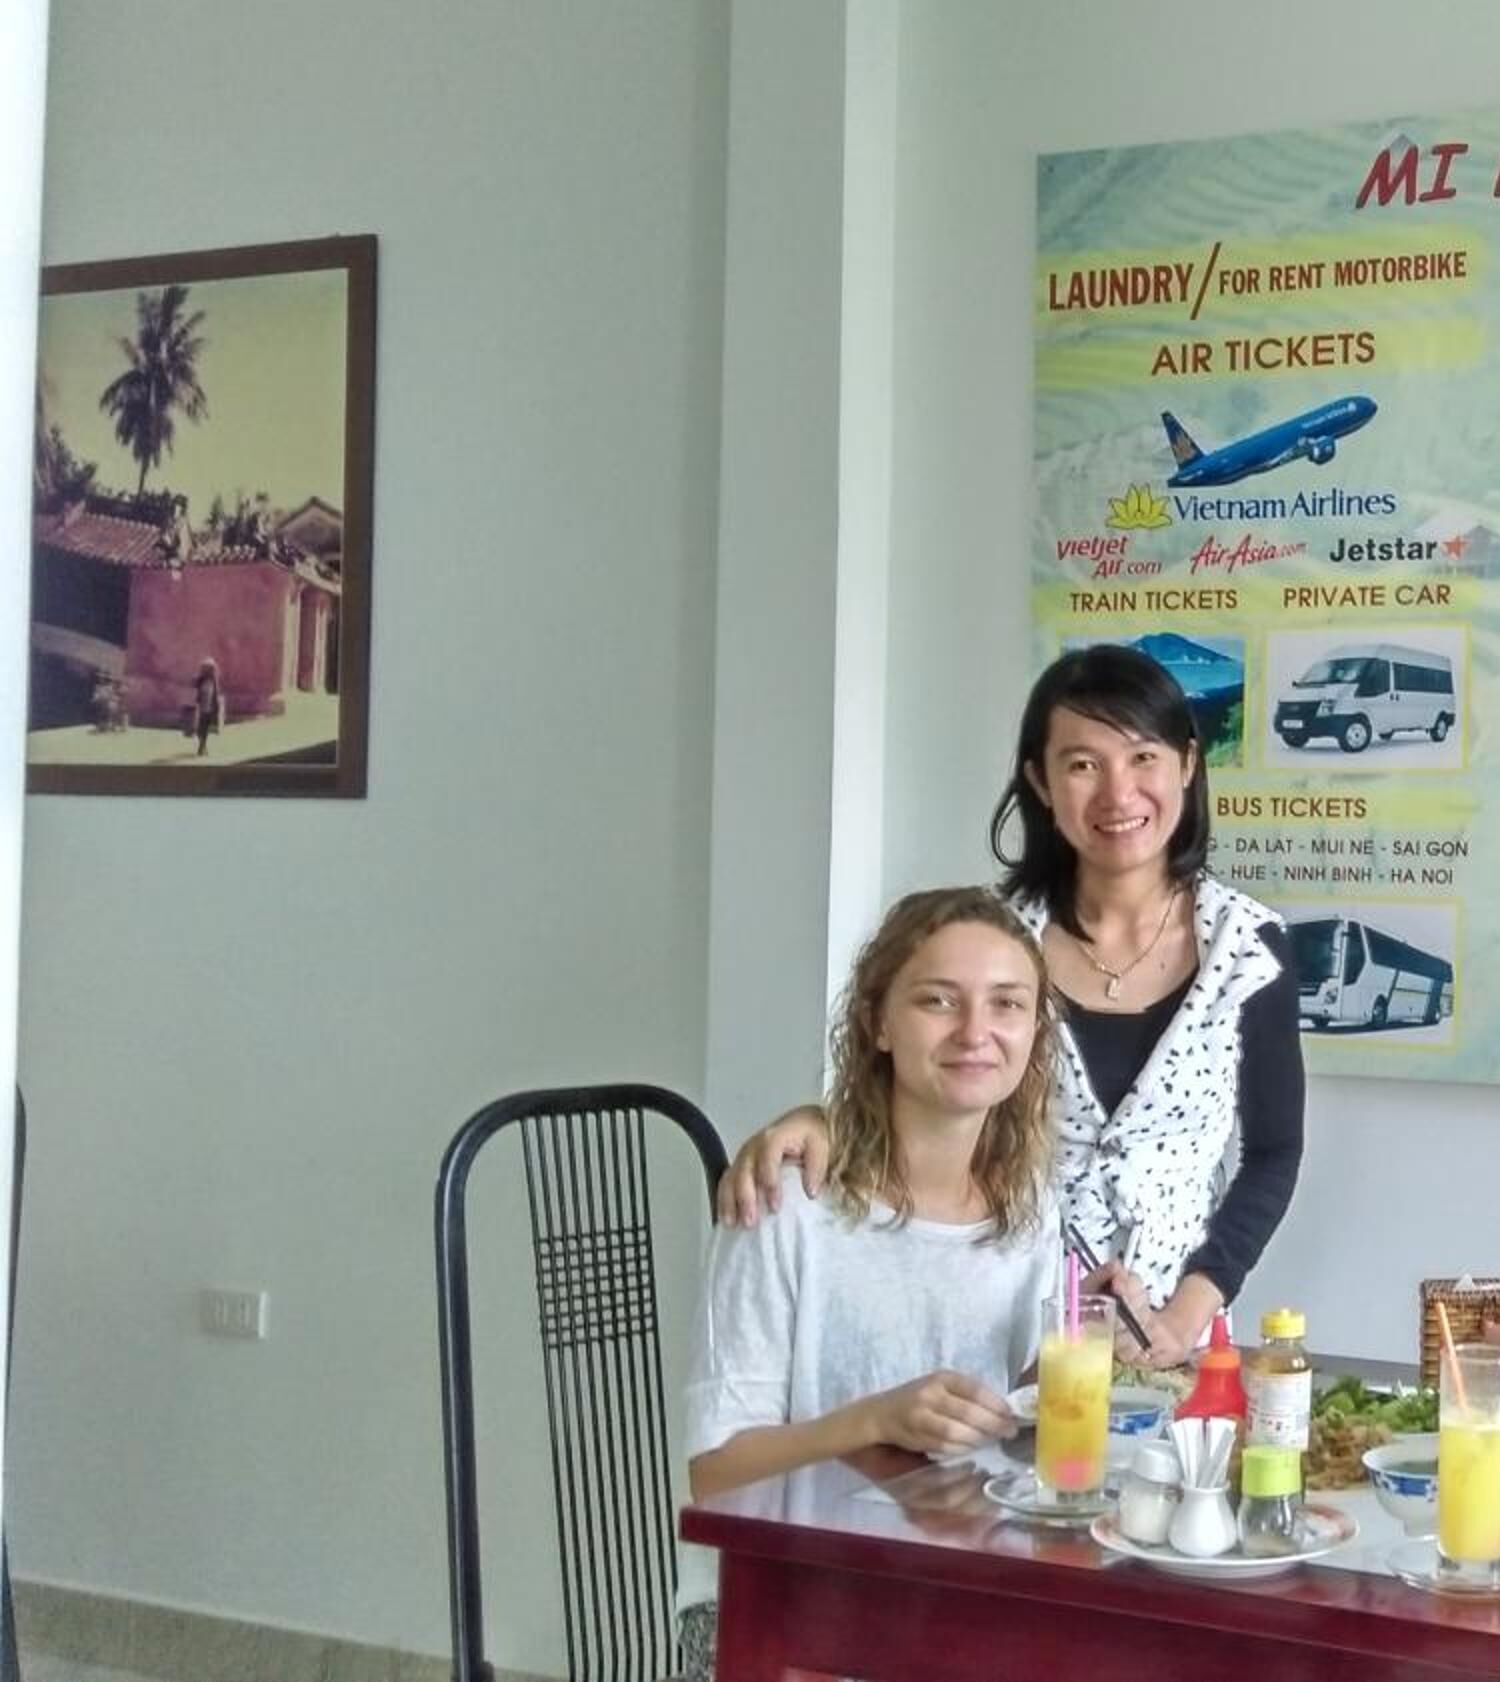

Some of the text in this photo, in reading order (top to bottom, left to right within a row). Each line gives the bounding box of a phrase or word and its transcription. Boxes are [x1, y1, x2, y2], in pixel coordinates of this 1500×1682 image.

[1356, 143, 1468, 209] MI
[1219, 269, 1260, 295] FOR
[1269, 263, 1325, 292] RENT
[1334, 251, 1467, 287] MOTORBIKE
[1151, 332, 1376, 376] AIR TICKETS
[1171, 488, 1397, 522] Vietnam Airlines
[1329, 537, 1438, 562] Jetstar
[1070, 589, 1238, 613] TRAIN TICKETS
[1283, 583, 1451, 608] PRIVATE CAR
[1217, 797, 1367, 819] BUS TICKETS
[1235, 837, 1260, 853] DA
[1265, 838, 1294, 853] LAT
[1311, 839, 1344, 855] MUI
[1350, 840, 1374, 855] NE
[1392, 840, 1420, 856] SAI
[1426, 840, 1469, 857] GON
[1231, 864, 1266, 881] HUE
[1284, 865, 1326, 882] NINH
[1332, 867, 1372, 883] BINH
[1391, 868, 1415, 884] HA
[1422, 869, 1454, 885] NOI
